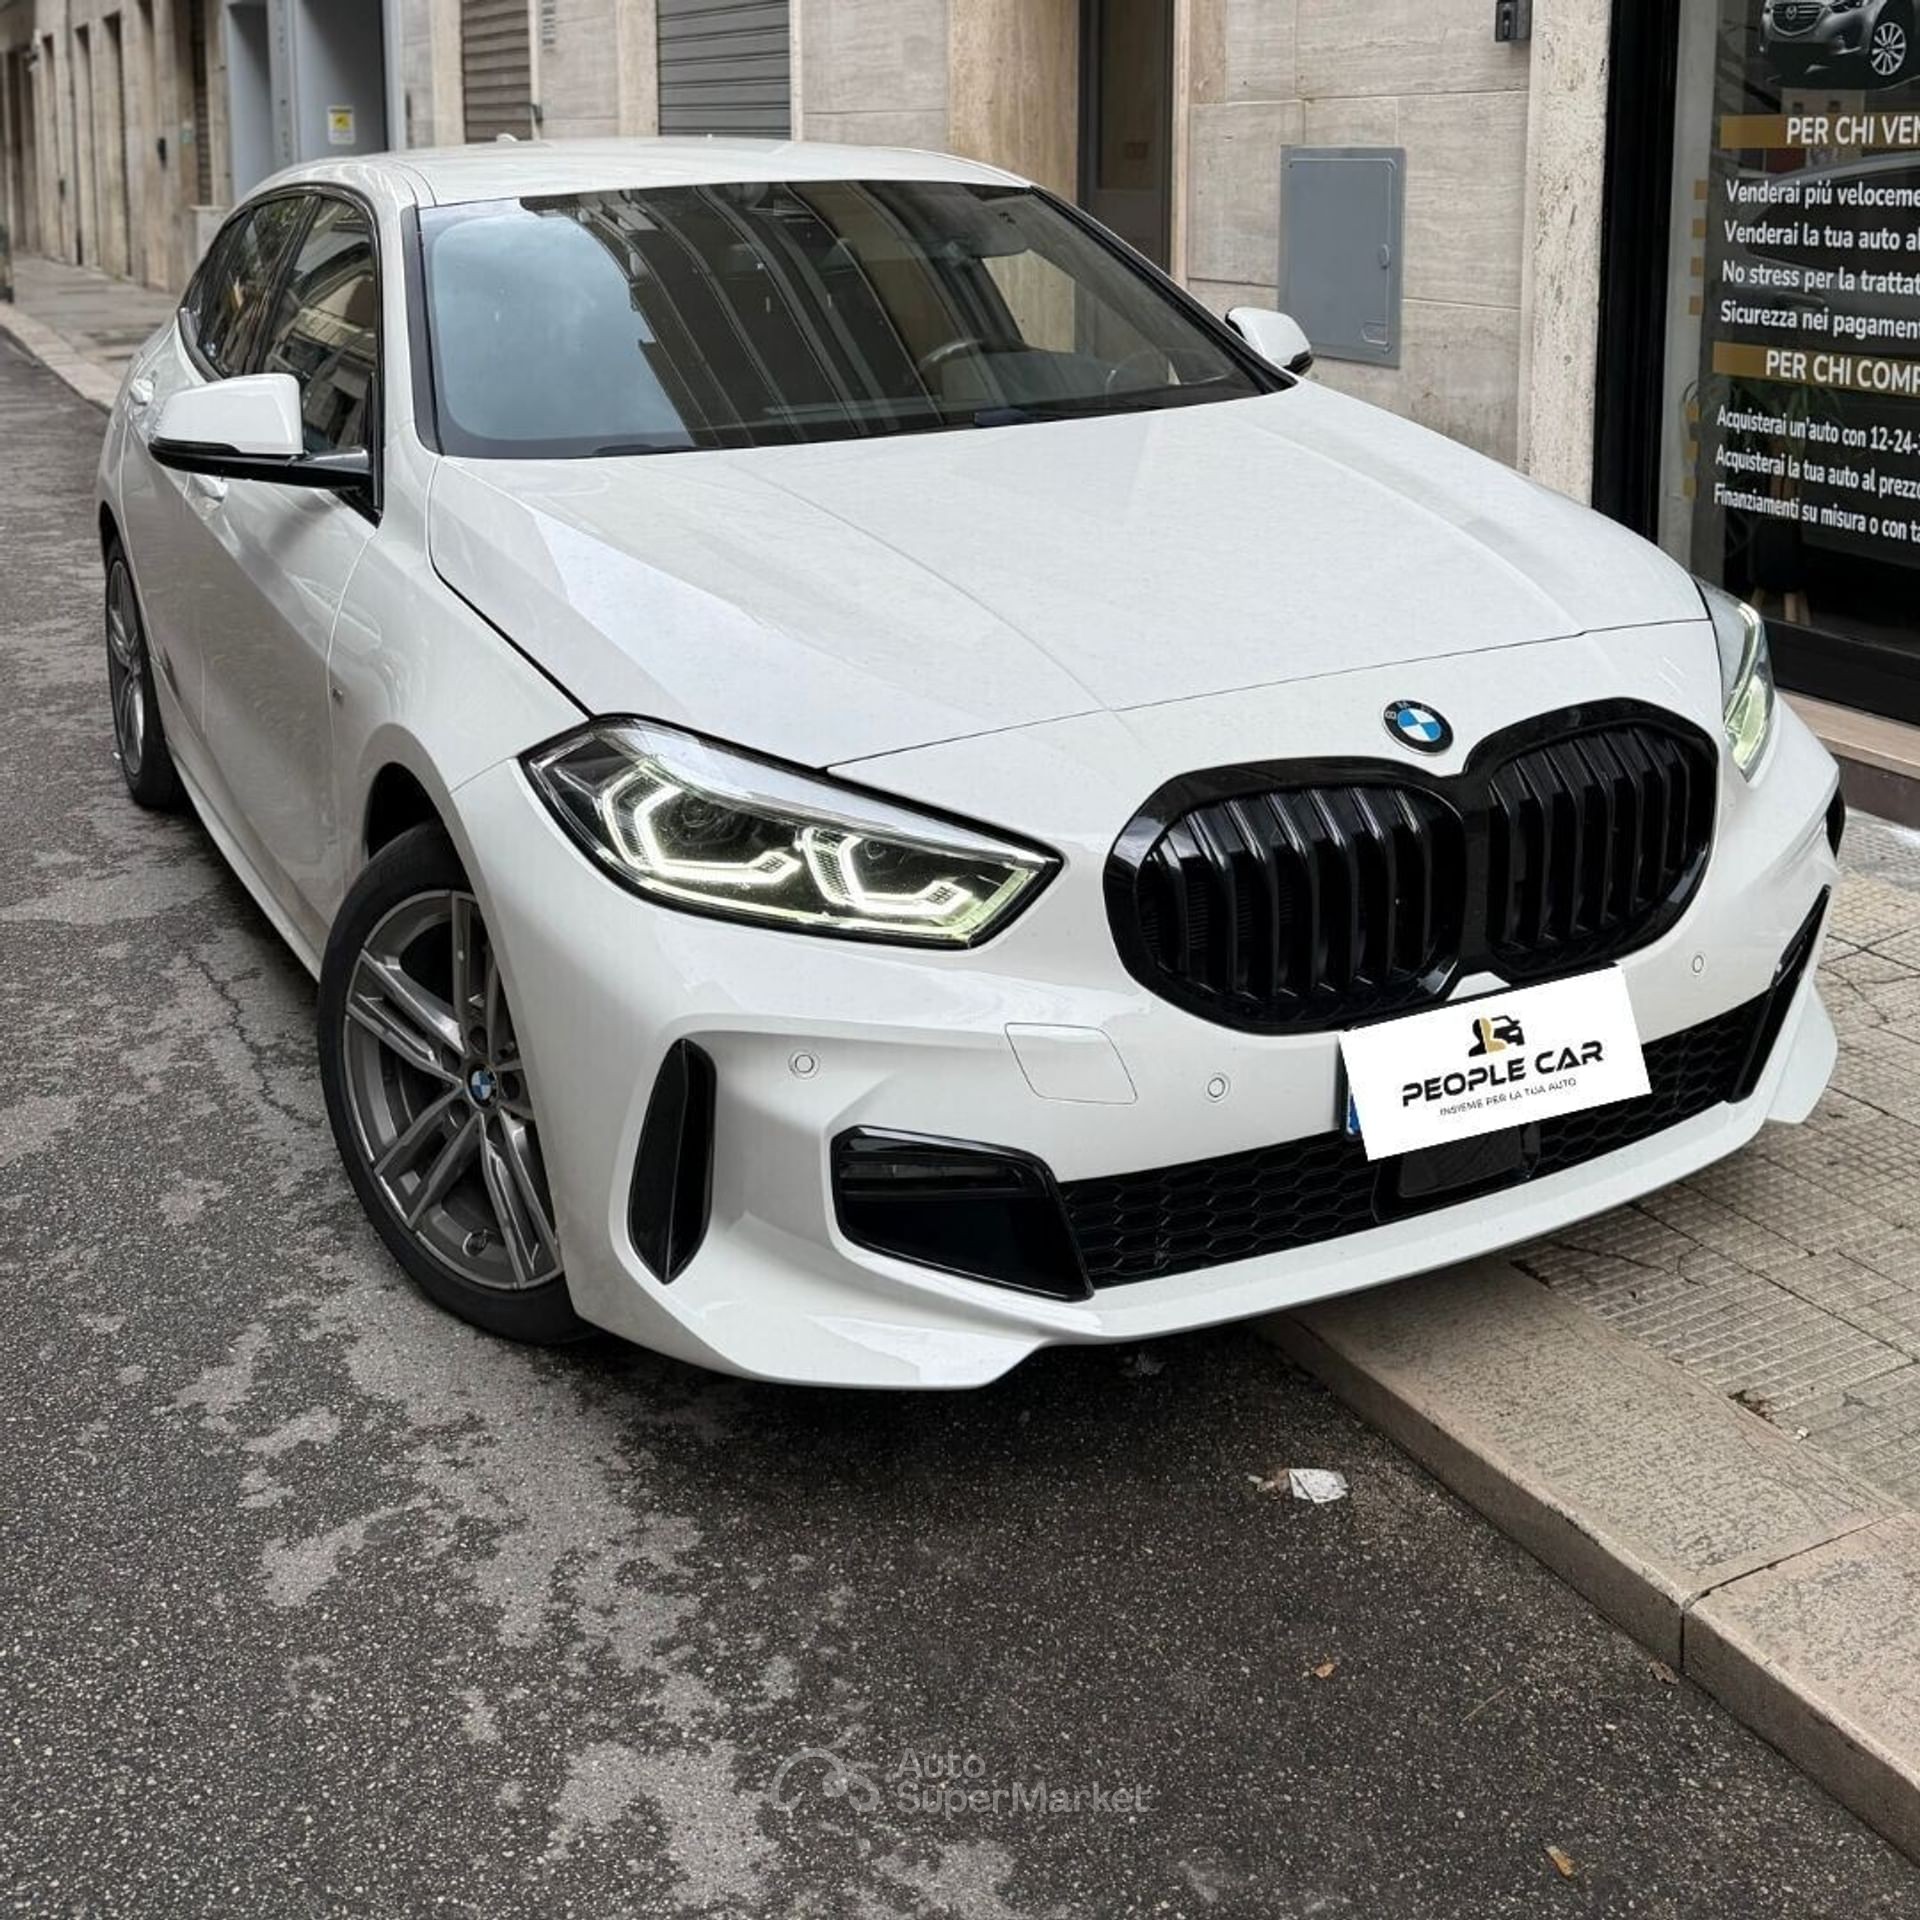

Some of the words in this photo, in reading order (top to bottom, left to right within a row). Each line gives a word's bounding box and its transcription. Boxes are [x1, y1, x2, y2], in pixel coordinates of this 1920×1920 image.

[1786, 116, 1829, 144] PER
[1835, 115, 1875, 144] CHI
[1726, 179, 1800, 204] Venderai
[1724, 220, 1798, 245] Venderai
[1803, 222, 1819, 246] la
[1824, 225, 1853, 248] tua
[1858, 227, 1900, 251] auto
[1722, 260, 1745, 283] No
[1749, 263, 1800, 287] stress
[1804, 269, 1834, 293] per
[1839, 266, 1855, 290] la
[1720, 300, 1797, 328] Sicurezza
[1802, 307, 1829, 331] nei
[1833, 314, 1920, 340] pagamen
[1765, 349, 1807, 380] PER
[1813, 355, 1850, 385] CHI
[1716, 404, 1786, 434] Acquisterai
[1789, 416, 1839, 444] un'auto
[1841, 429, 1866, 447] con
[1870, 425, 1920, 455] 12-24-
[1715, 443, 1785, 475] Acquisterai
[1788, 455, 1800, 478] la
[1803, 459, 1825, 482] tua
[1827, 466, 1859, 488] auto
[1861, 467, 1876, 492] al
[1713, 483, 1799, 520] Finanziamenti
[1802, 503, 1818, 523] su
[1820, 503, 1866, 533] misura
[1869, 517, 1879, 534] o
[1882, 518, 1907, 540] con
